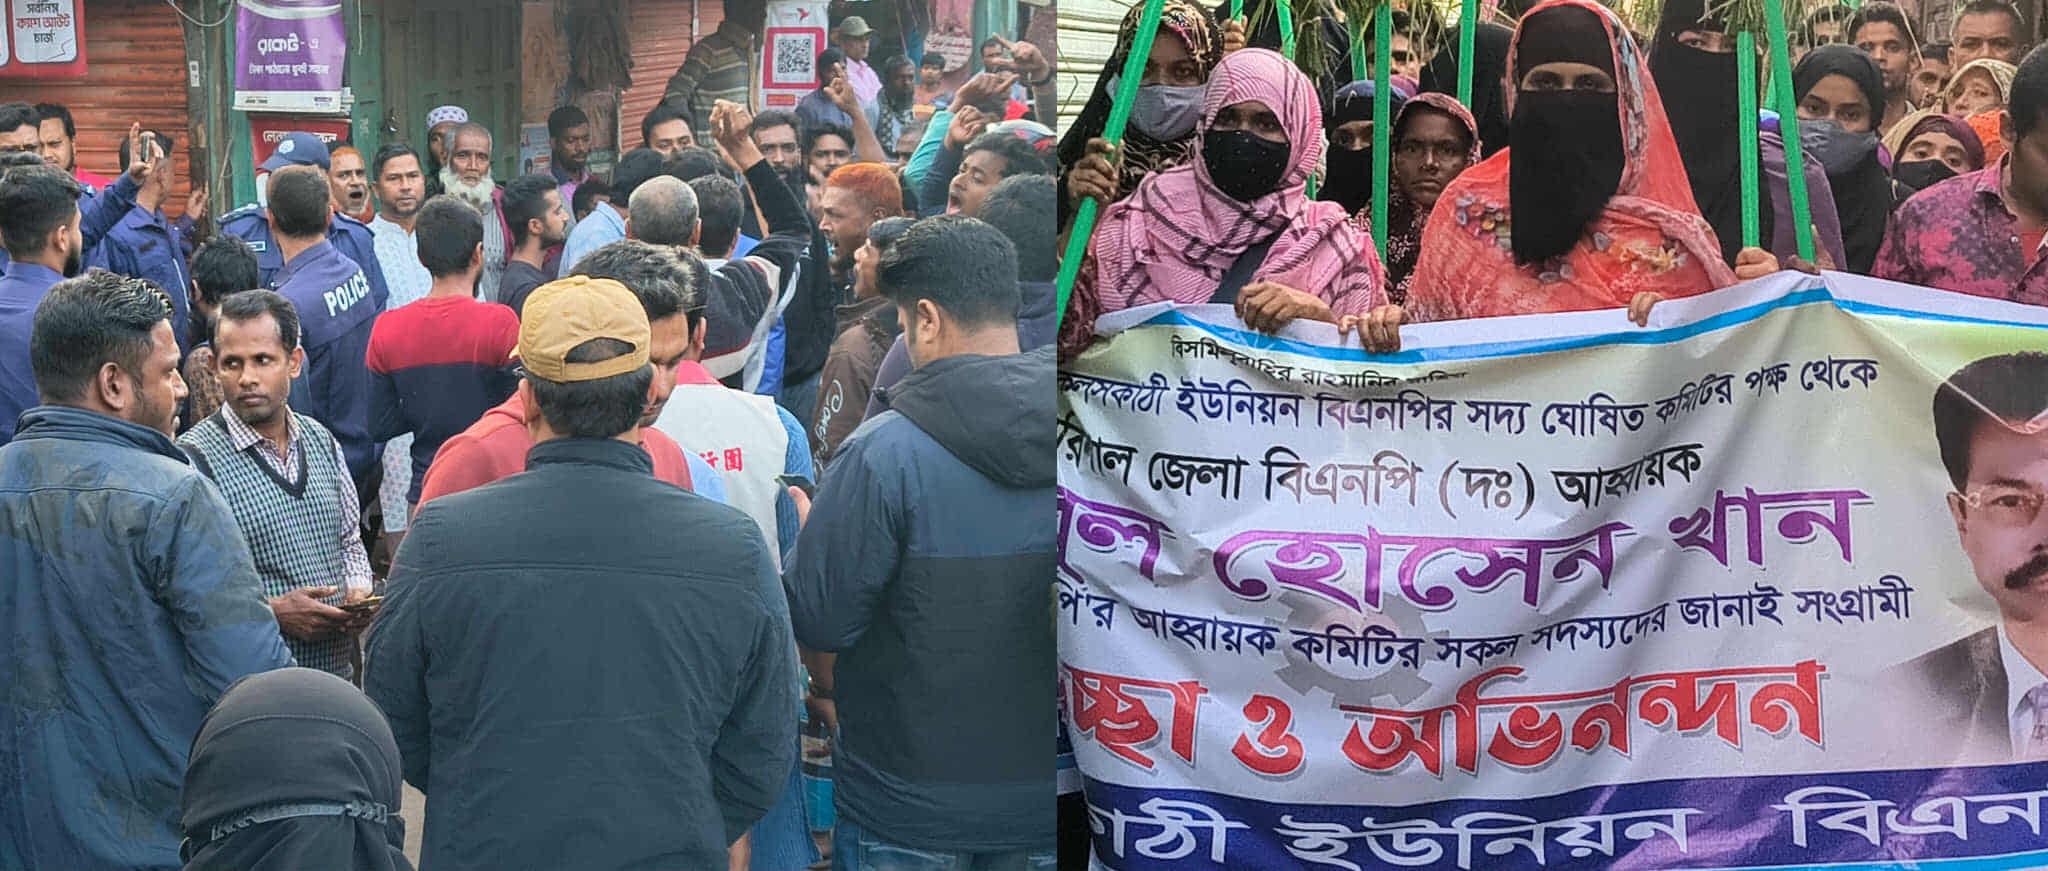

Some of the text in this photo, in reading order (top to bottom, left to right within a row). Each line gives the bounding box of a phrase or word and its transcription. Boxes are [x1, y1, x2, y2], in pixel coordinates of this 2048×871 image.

[42, 13, 71, 29] আউট
[323, 268, 370, 317] POLICE
[1177, 376, 1302, 427] ইউনিয়ন
[1312, 388, 1456, 432] বিএনপির
[1464, 397, 1530, 435] সদ্য
[1541, 392, 1649, 437] ঘোষিত
[1655, 372, 1736, 425] কমিটির
[1745, 362, 1791, 396] পক্ষ
[1799, 355, 1880, 392] থেকে
[1148, 450, 1250, 500] জেলা
[1261, 445, 1423, 508] বিএনপি
[1213, 521, 1636, 613] হোসেন
[1669, 486, 1872, 567] খান
[1289, 623, 1424, 670] কমিটির
[1436, 633, 1524, 669] সকল
[1532, 600, 1672, 652] সদস্যদের
[1678, 582, 1783, 629] জানাই
[1792, 575, 1914, 626] সংগ্রামী
[1231, 692, 1305, 776] ও
[1339, 659, 1826, 778] অভিনন্দন
[1274, 807, 1703, 871] ইউনিয়ন
